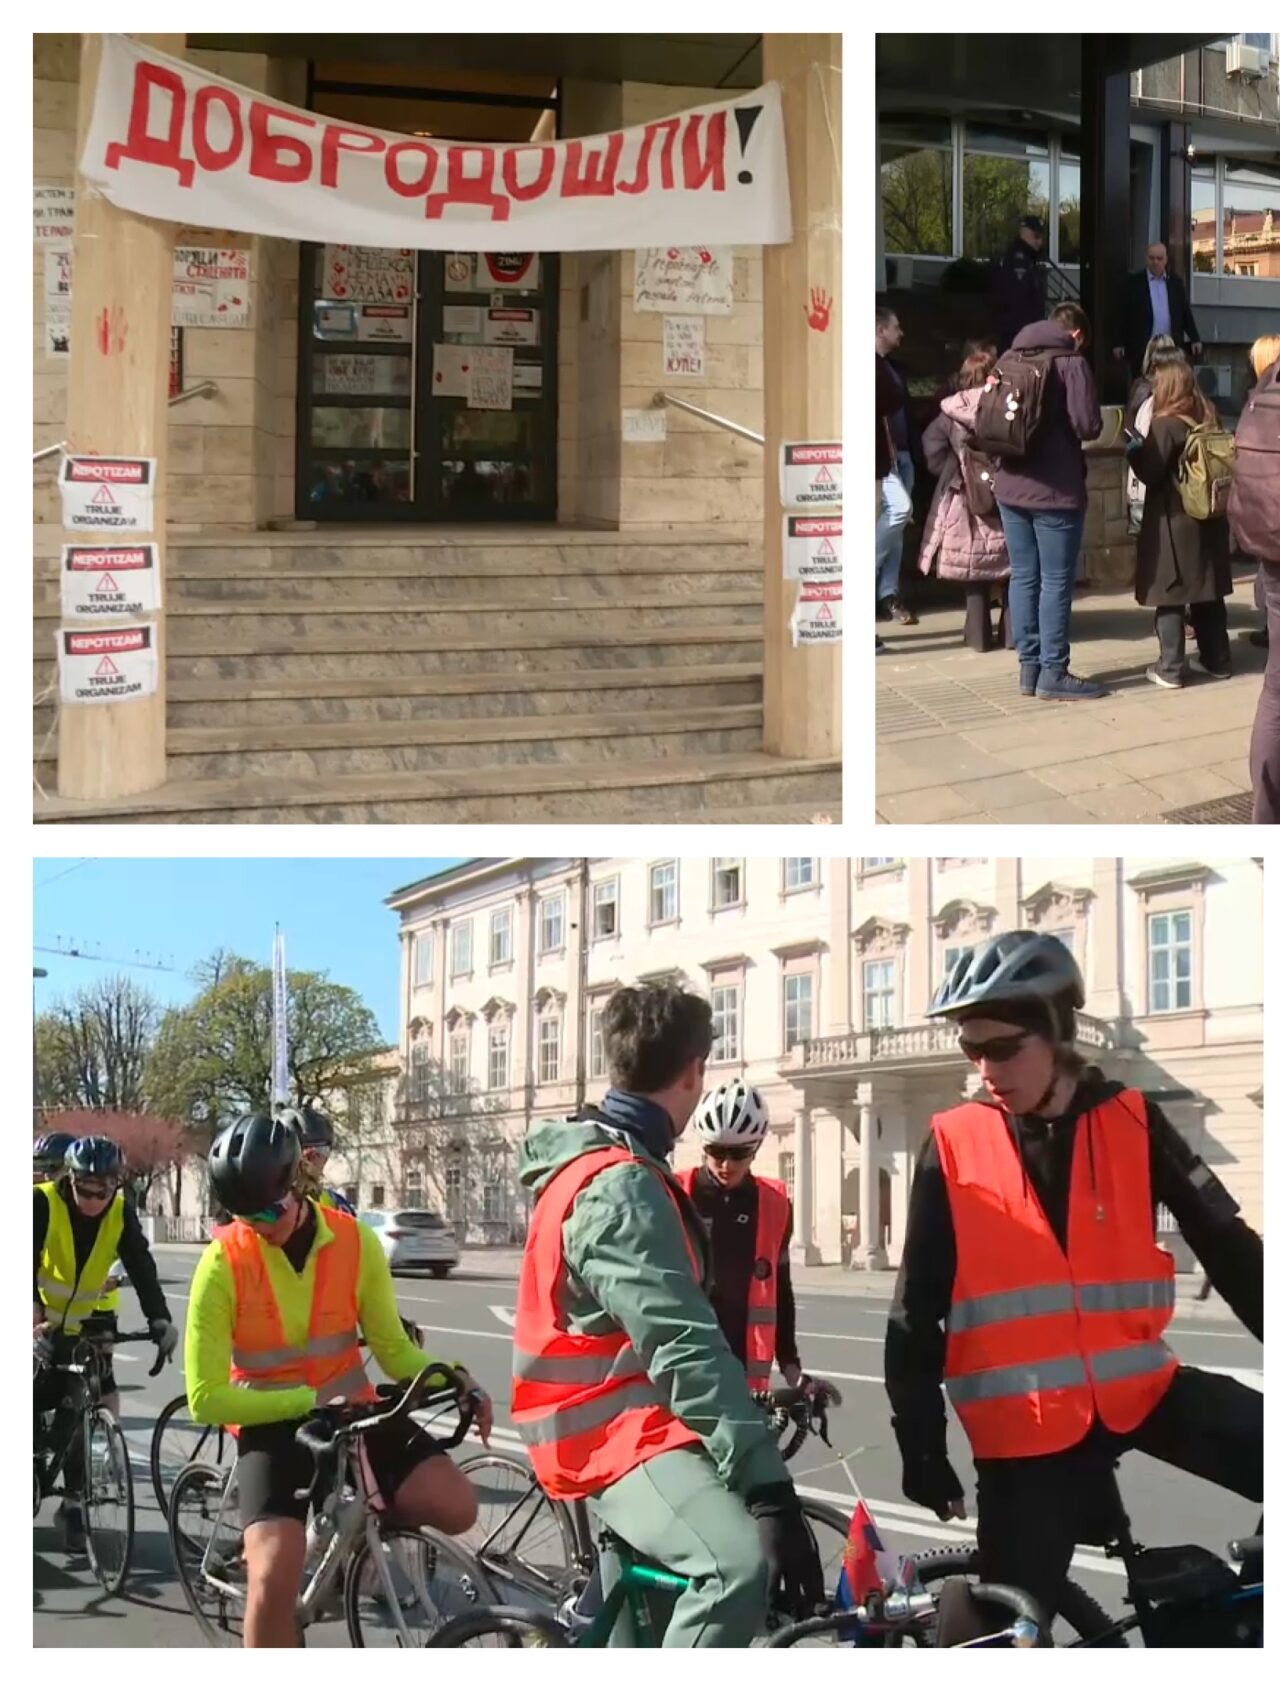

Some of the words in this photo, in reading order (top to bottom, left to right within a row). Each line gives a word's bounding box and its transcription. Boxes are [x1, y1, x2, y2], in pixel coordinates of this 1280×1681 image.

[104, 61, 764, 221] ДОБРОДОШЛИ!
[72, 464, 142, 478] NEPOTIZAM
[84, 505, 122, 515] TRUJE
[72, 515, 137, 526] ORGANIZAM
[73, 552, 144, 567] NEPOTIZAM
[87, 593, 126, 603] TRUJE
[75, 603, 143, 614] ORGANIZAM
[70, 633, 143, 649] NEPOTIZAM
[87, 674, 127, 686] TRUJE
[75, 683, 142, 698] ORGANIZAM
